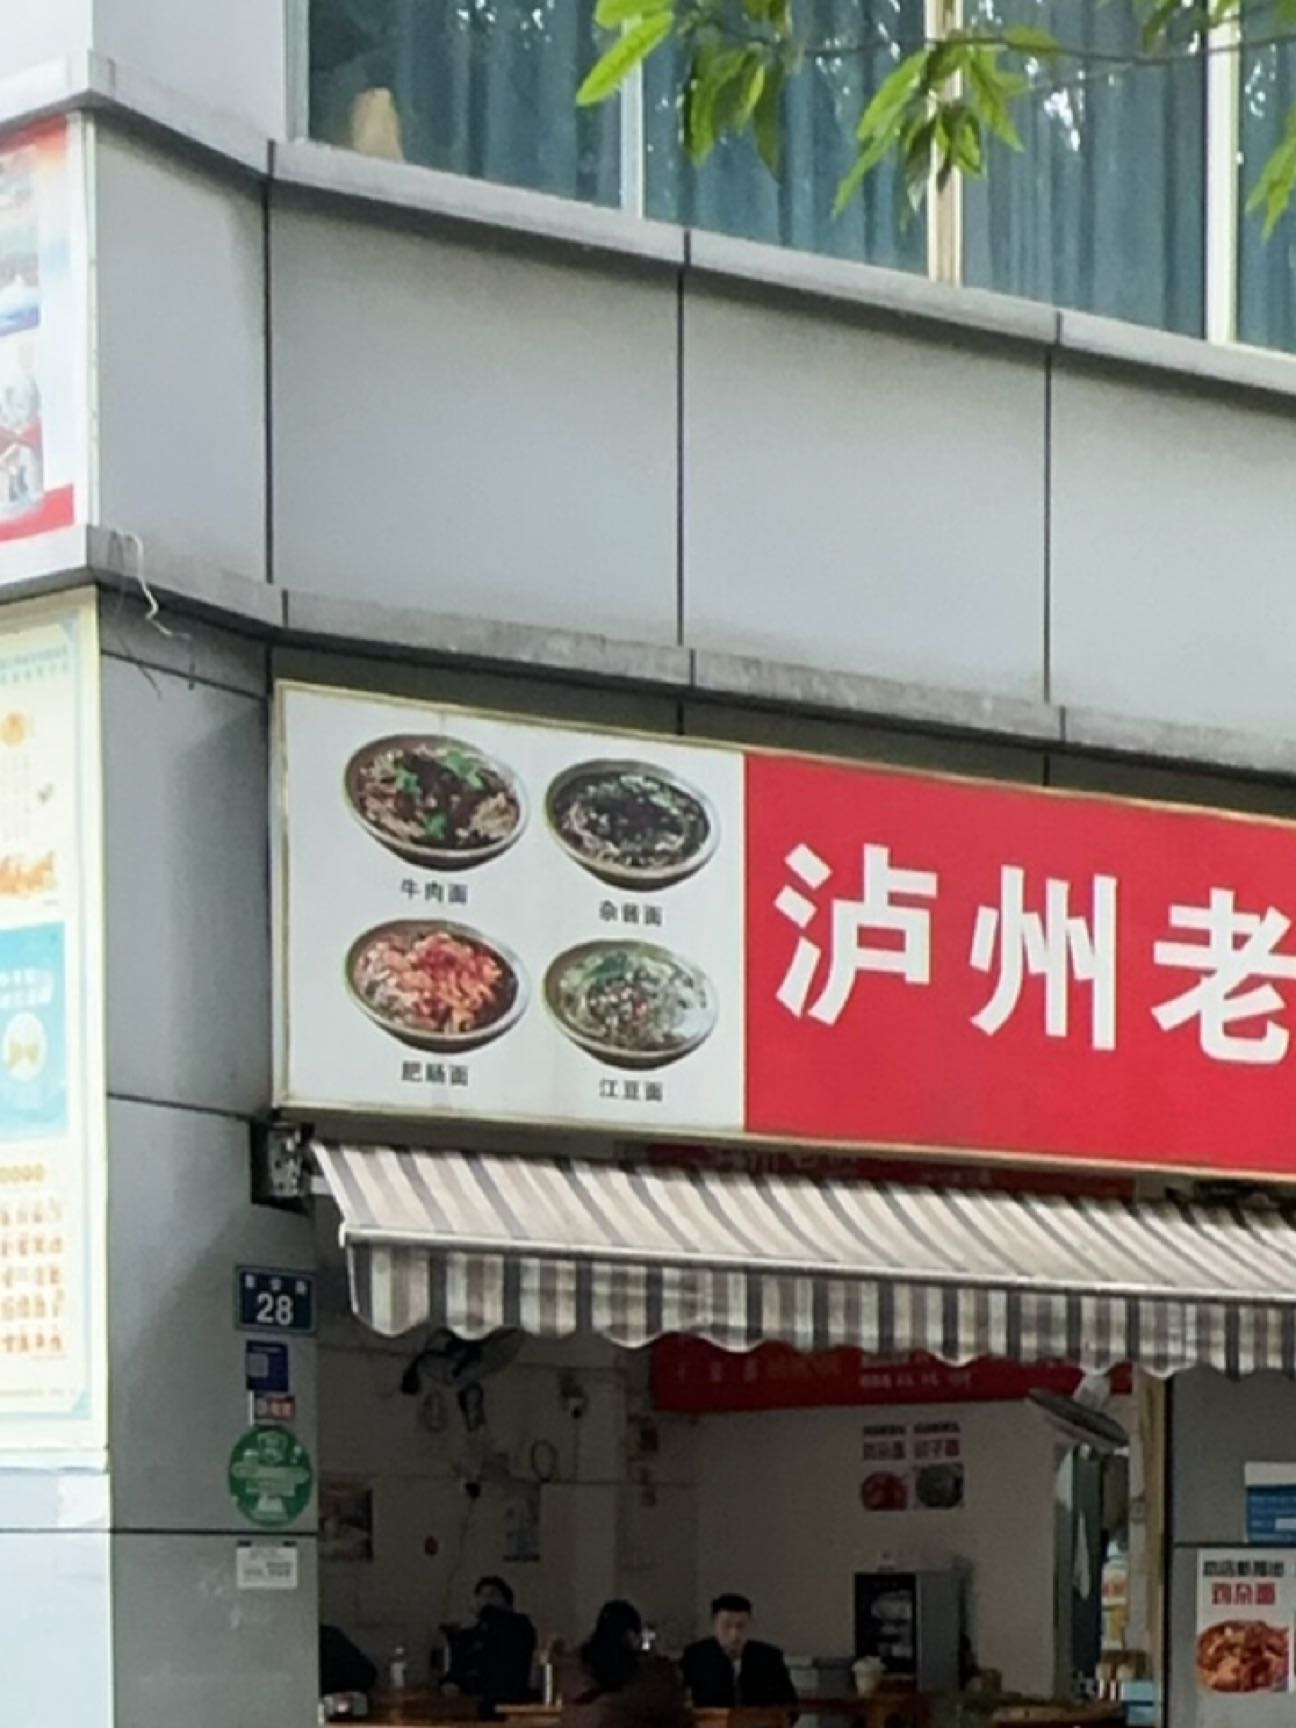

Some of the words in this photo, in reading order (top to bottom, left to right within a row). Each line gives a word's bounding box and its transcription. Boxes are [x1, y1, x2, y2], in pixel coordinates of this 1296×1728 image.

[401, 879, 468, 904] 牛肉面
[599, 900, 663, 927] 杂酱面
[401, 1062, 469, 1086] 肥肠面
[599, 1080, 663, 1103] 江豆面
[256, 1292, 294, 1326] 28
